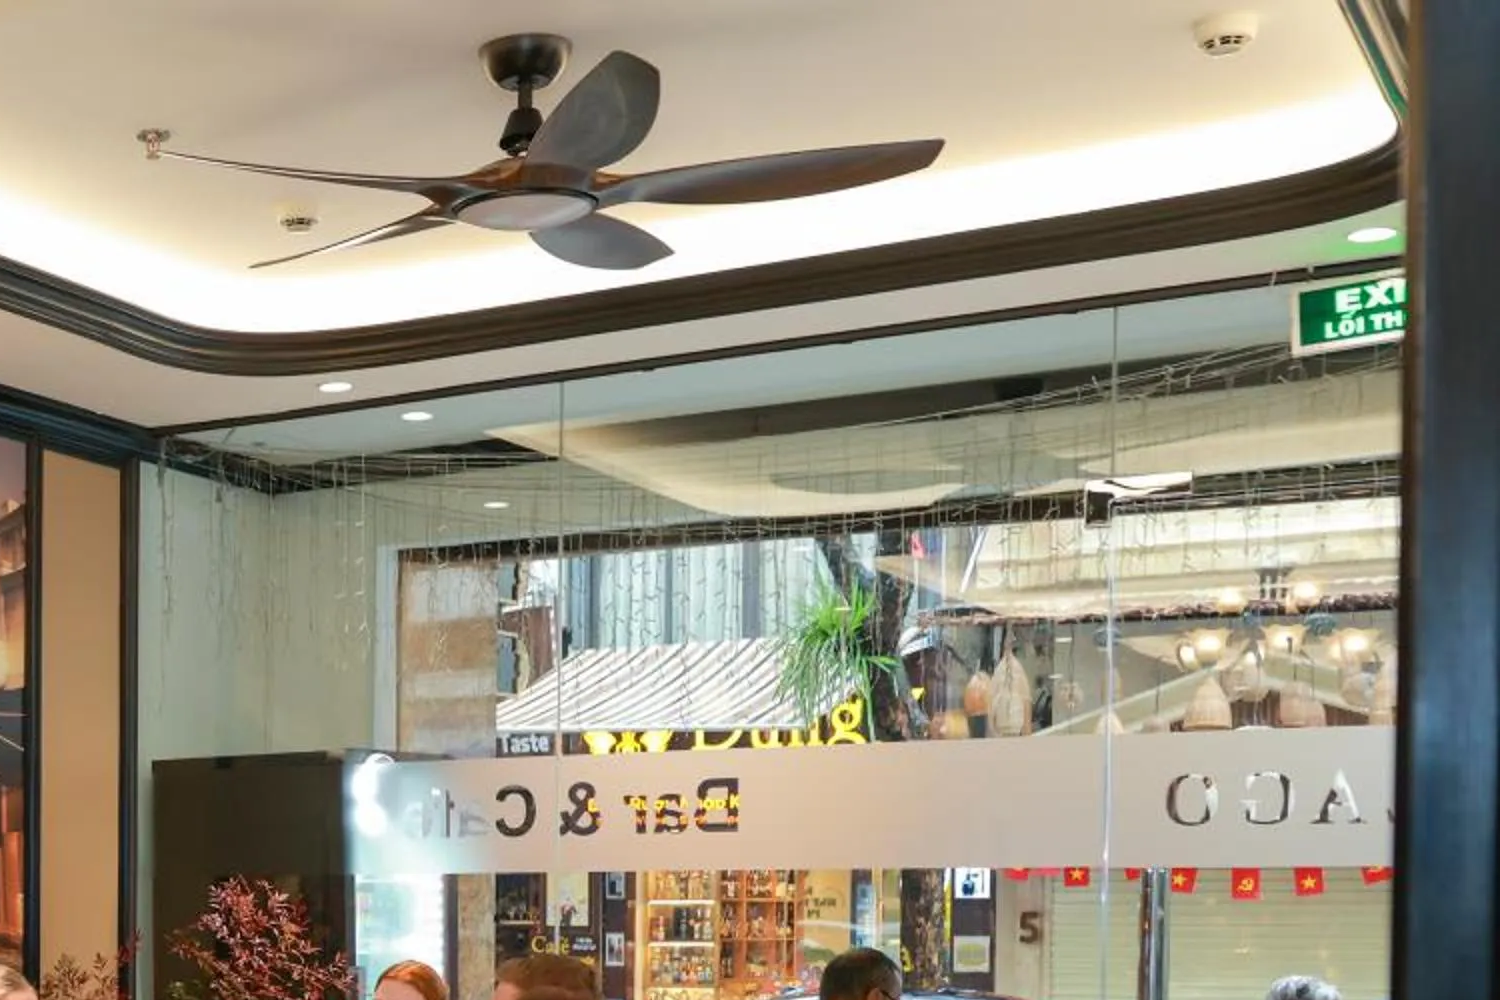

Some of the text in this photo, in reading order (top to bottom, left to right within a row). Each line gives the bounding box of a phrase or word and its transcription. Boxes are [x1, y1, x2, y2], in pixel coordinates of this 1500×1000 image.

[1369, 309, 1407, 330] TH
[501, 733, 549, 753] Taste
[1019, 911, 1041, 944] 5
